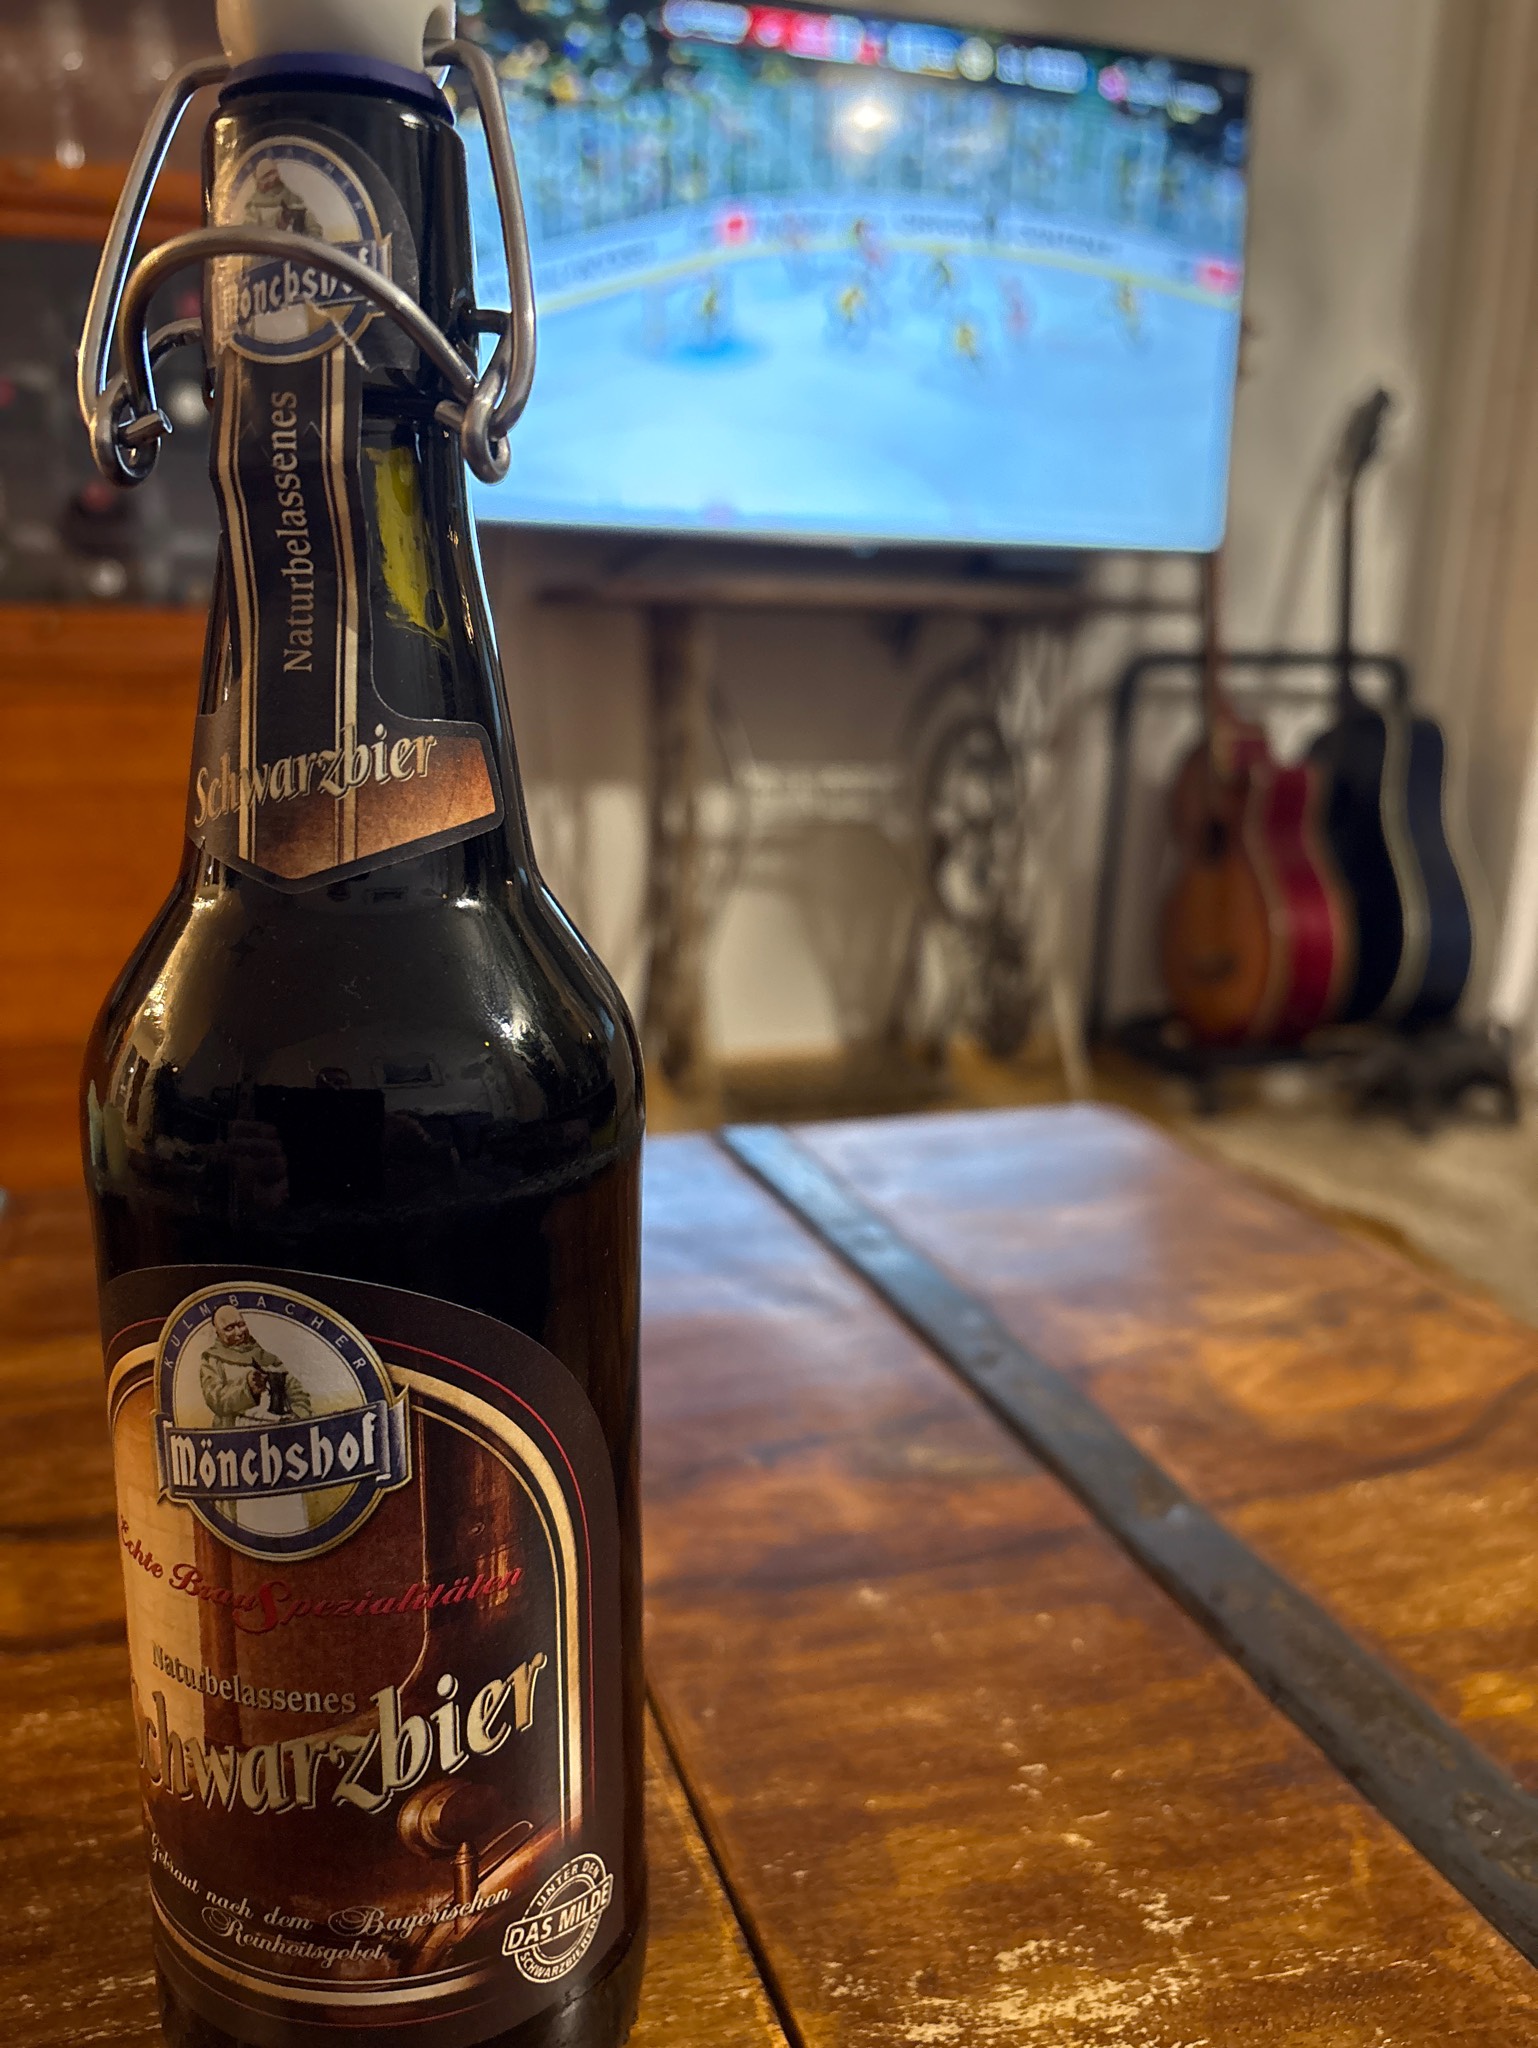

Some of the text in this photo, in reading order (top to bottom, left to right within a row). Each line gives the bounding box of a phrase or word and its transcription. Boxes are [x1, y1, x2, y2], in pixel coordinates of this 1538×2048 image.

[271, 391, 315, 673] Naturbelassenes
[194, 722, 438, 828] Schwarzbier
[163, 1294, 367, 1369] KULMBACHER
[169, 1411, 378, 1489] Mönchshof
[152, 1639, 357, 1715] Naturbelassenes
[205, 1890, 254, 1920] nach
[263, 1906, 313, 1932] dem
[327, 1887, 512, 1939] Bayerischen
[507, 1881, 610, 1951] DAS MILDE
[536, 1860, 600, 1908] UNTER DEN
[201, 1906, 386, 1969] Reinheitsgebot
